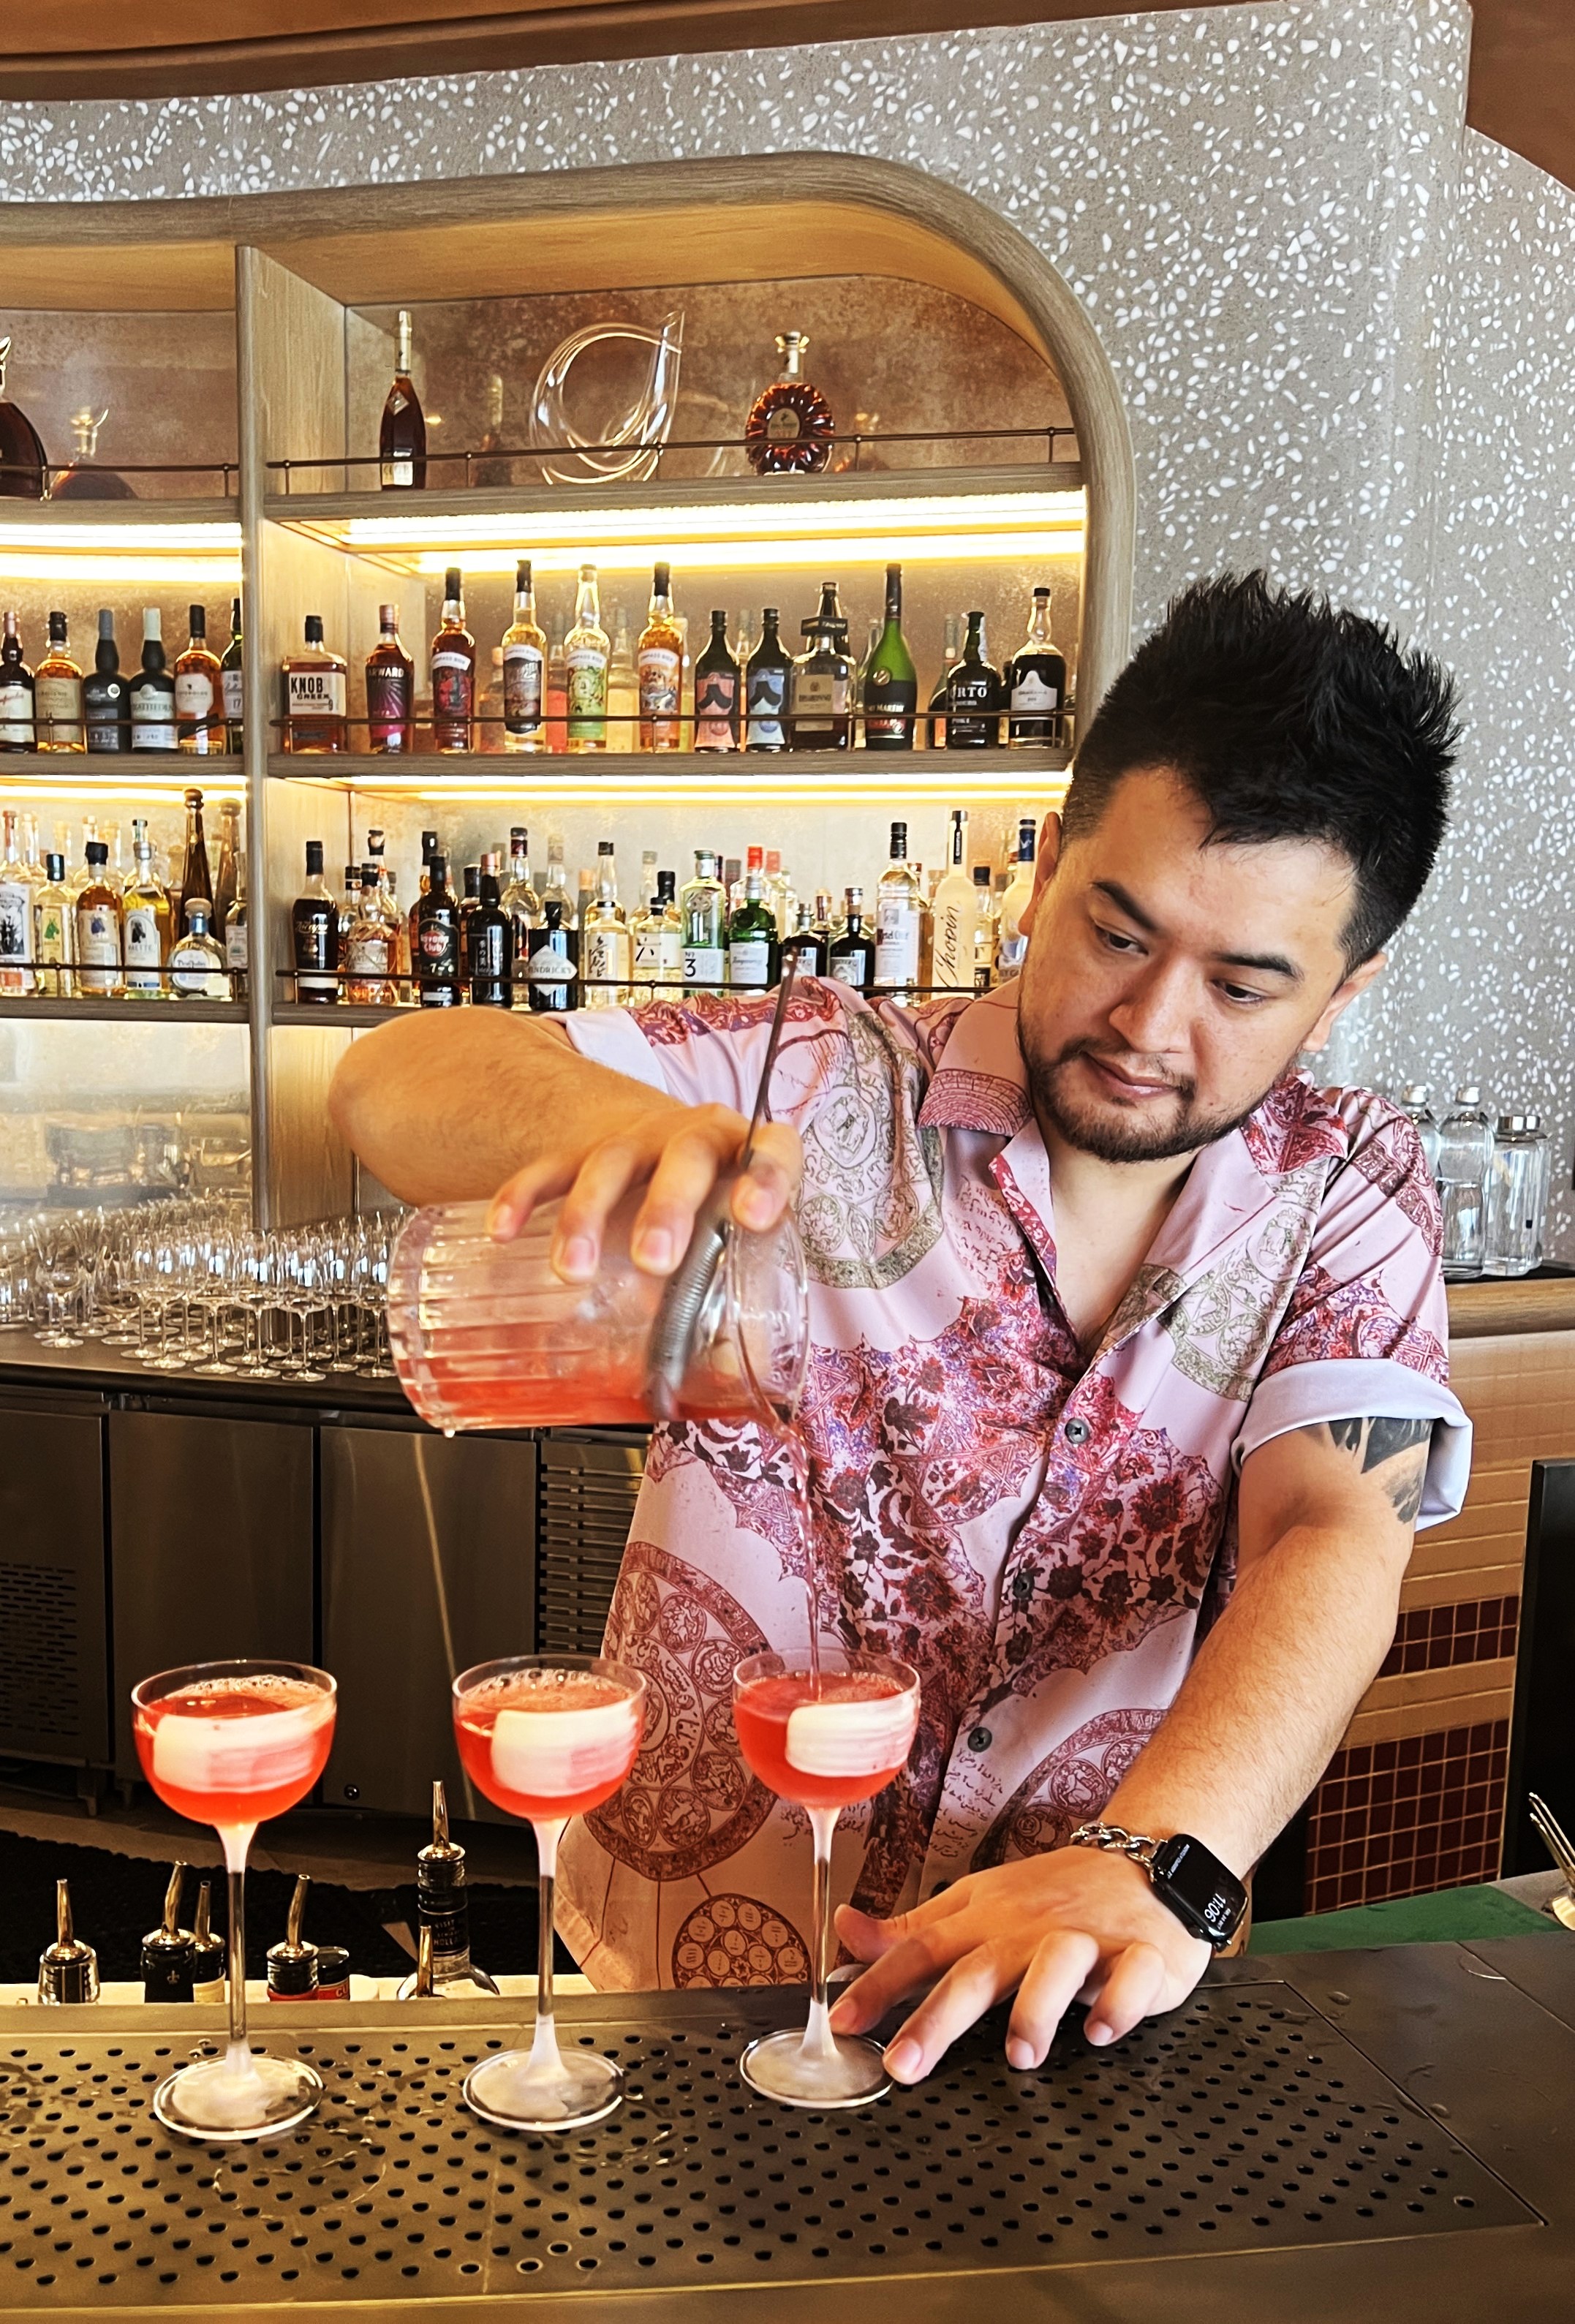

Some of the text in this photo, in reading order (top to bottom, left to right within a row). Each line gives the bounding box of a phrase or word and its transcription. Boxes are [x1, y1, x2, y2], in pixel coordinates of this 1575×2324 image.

[290, 676, 323, 693] KNOB
[935, 904, 960, 987] Chopin
[684, 959, 696, 977] 3
[1204, 1893, 1226, 1923] 11:06
